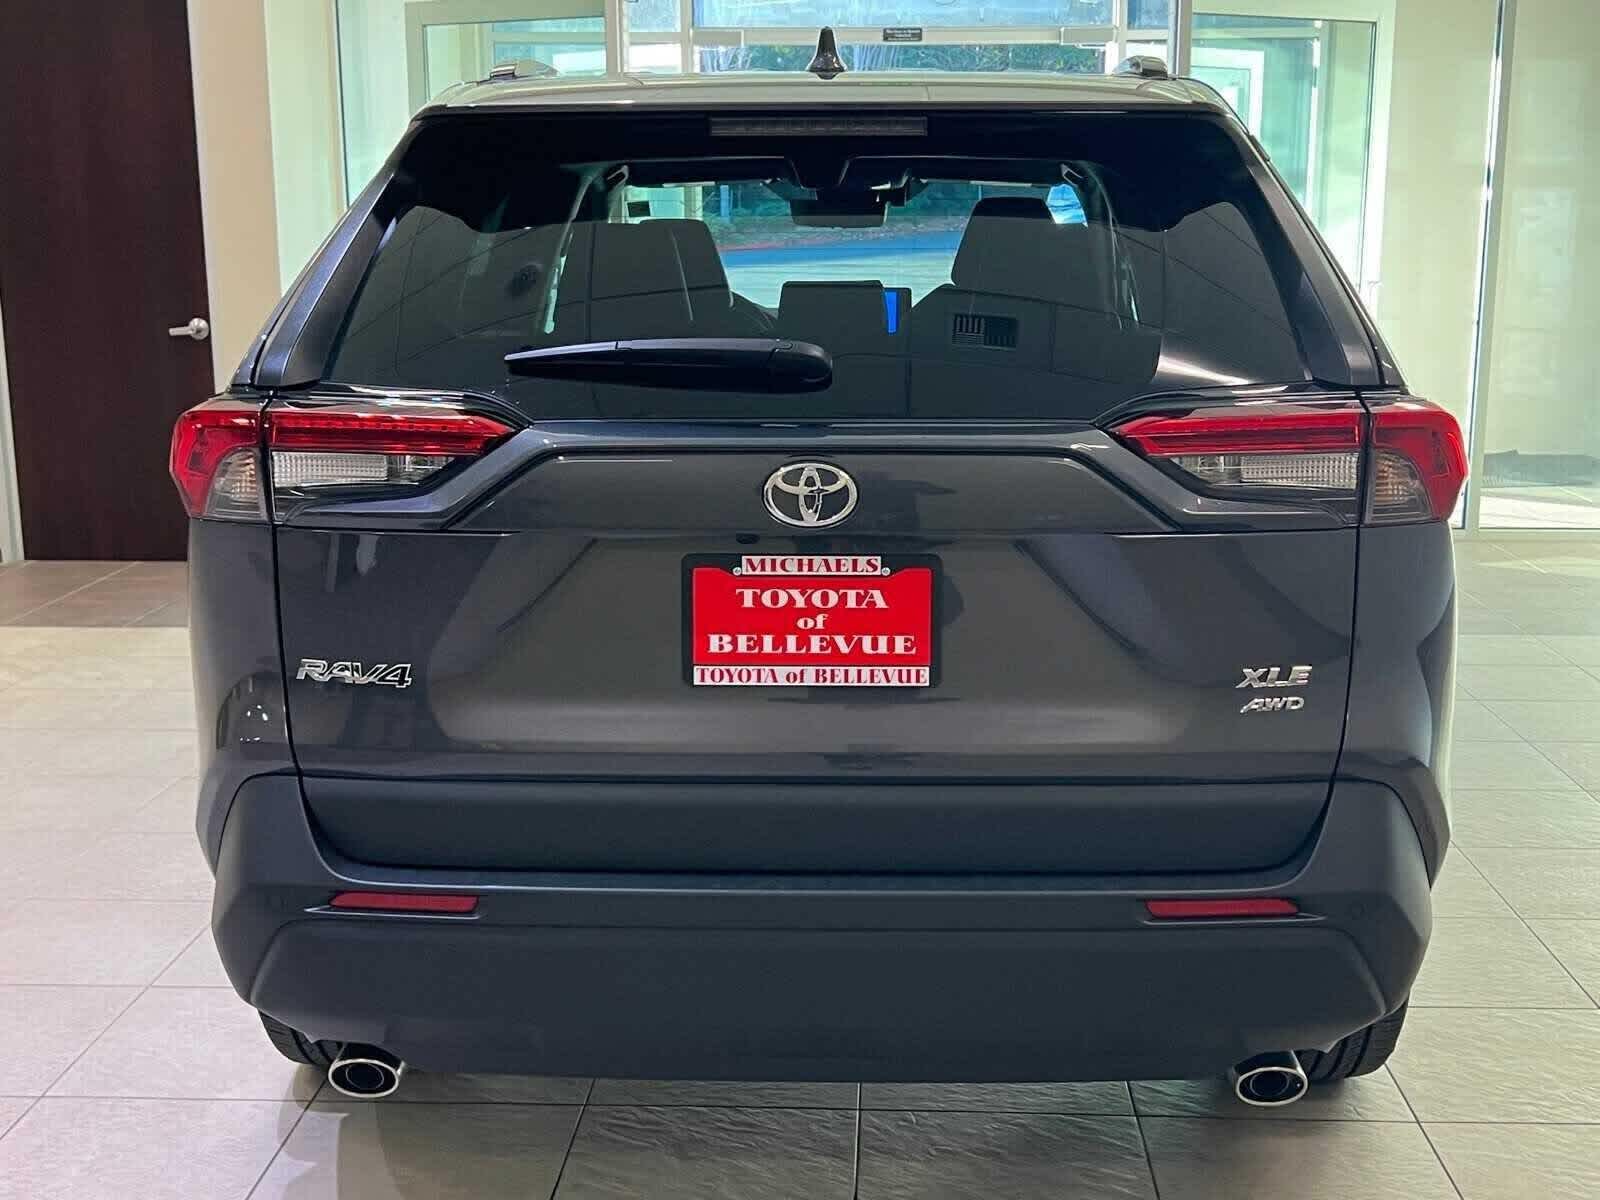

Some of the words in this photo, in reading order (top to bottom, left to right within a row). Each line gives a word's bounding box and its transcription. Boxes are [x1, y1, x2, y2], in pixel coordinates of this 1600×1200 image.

[745, 558, 879, 572] MICHAELS
[736, 588, 889, 609] TOYOTA
[797, 614, 828, 629] of
[708, 634, 916, 654] BELLEVUE
[296, 658, 412, 688] RAV4
[696, 668, 778, 684] TOYOTA
[785, 668, 807, 684] of
[815, 668, 927, 684] BELLEVUE
[1235, 665, 1312, 689] XLE
[1240, 697, 1304, 713] AWD
